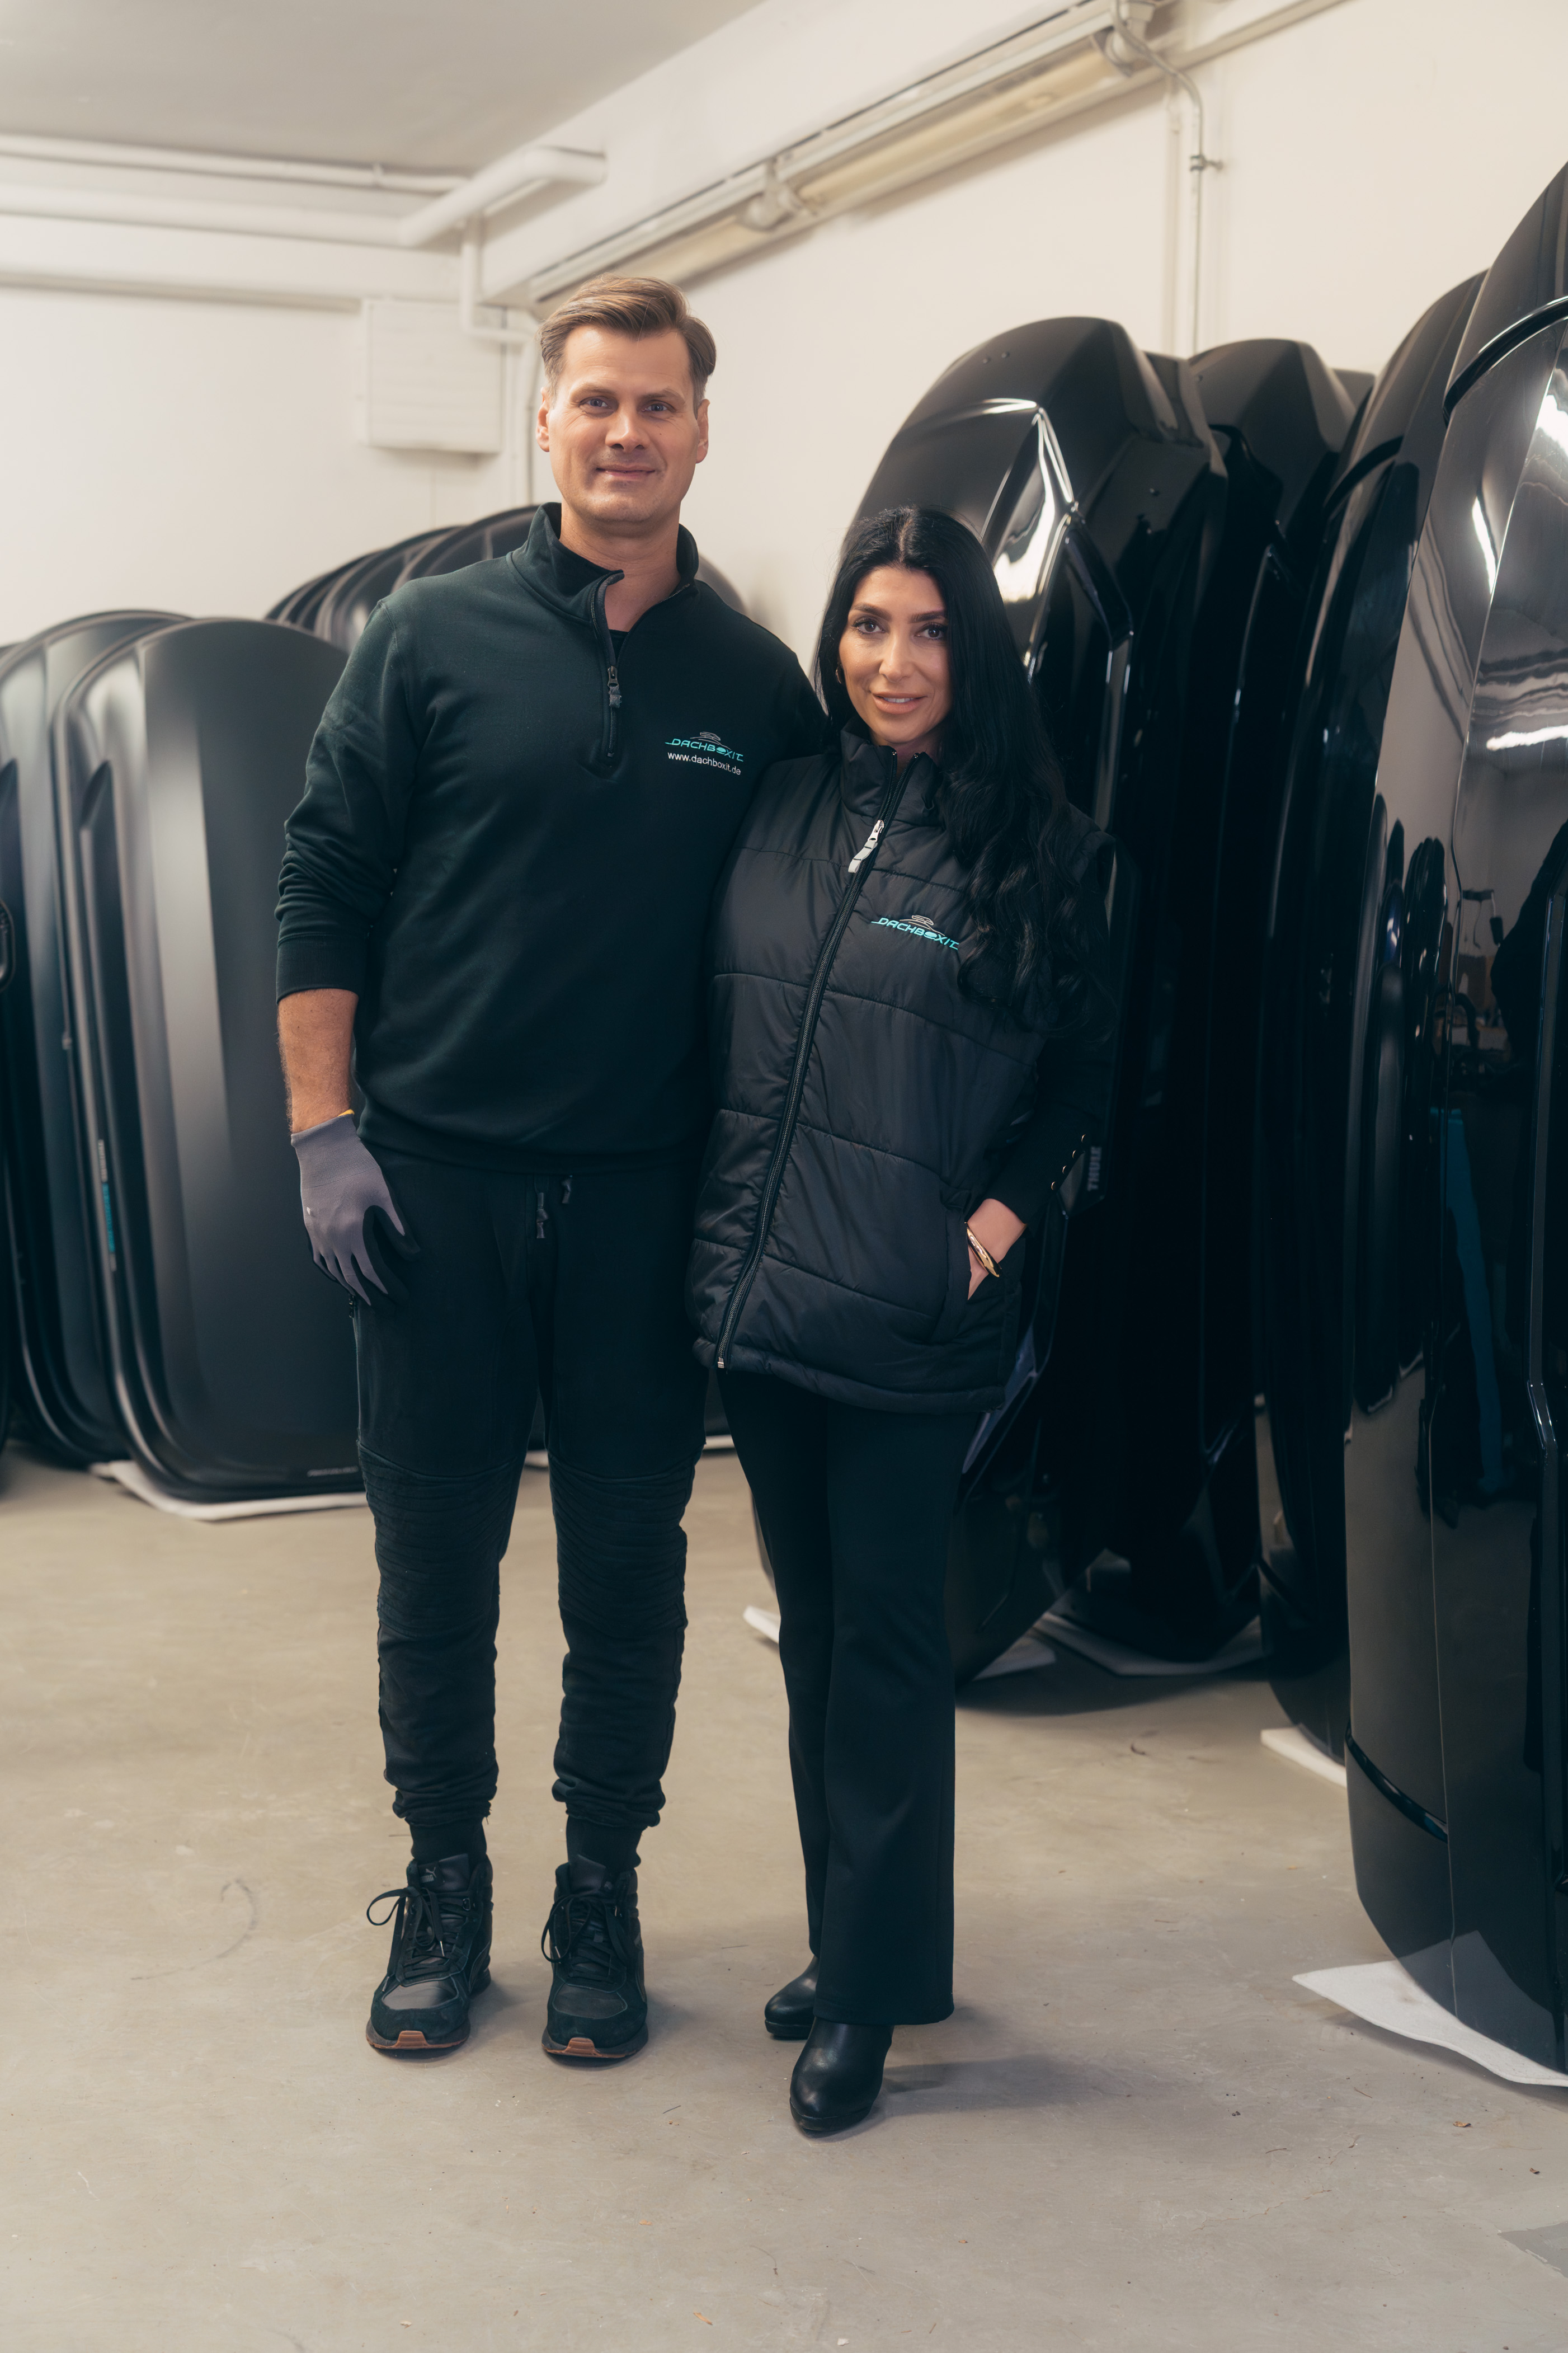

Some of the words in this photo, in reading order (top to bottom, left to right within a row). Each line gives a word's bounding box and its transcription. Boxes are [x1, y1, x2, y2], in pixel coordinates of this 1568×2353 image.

[665, 738, 743, 762] DACHBOXIT
[667, 752, 741, 775] www.dachboxit.de
[871, 917, 959, 950] DACHBOXIT
[1087, 1147, 1102, 1192] THULE
